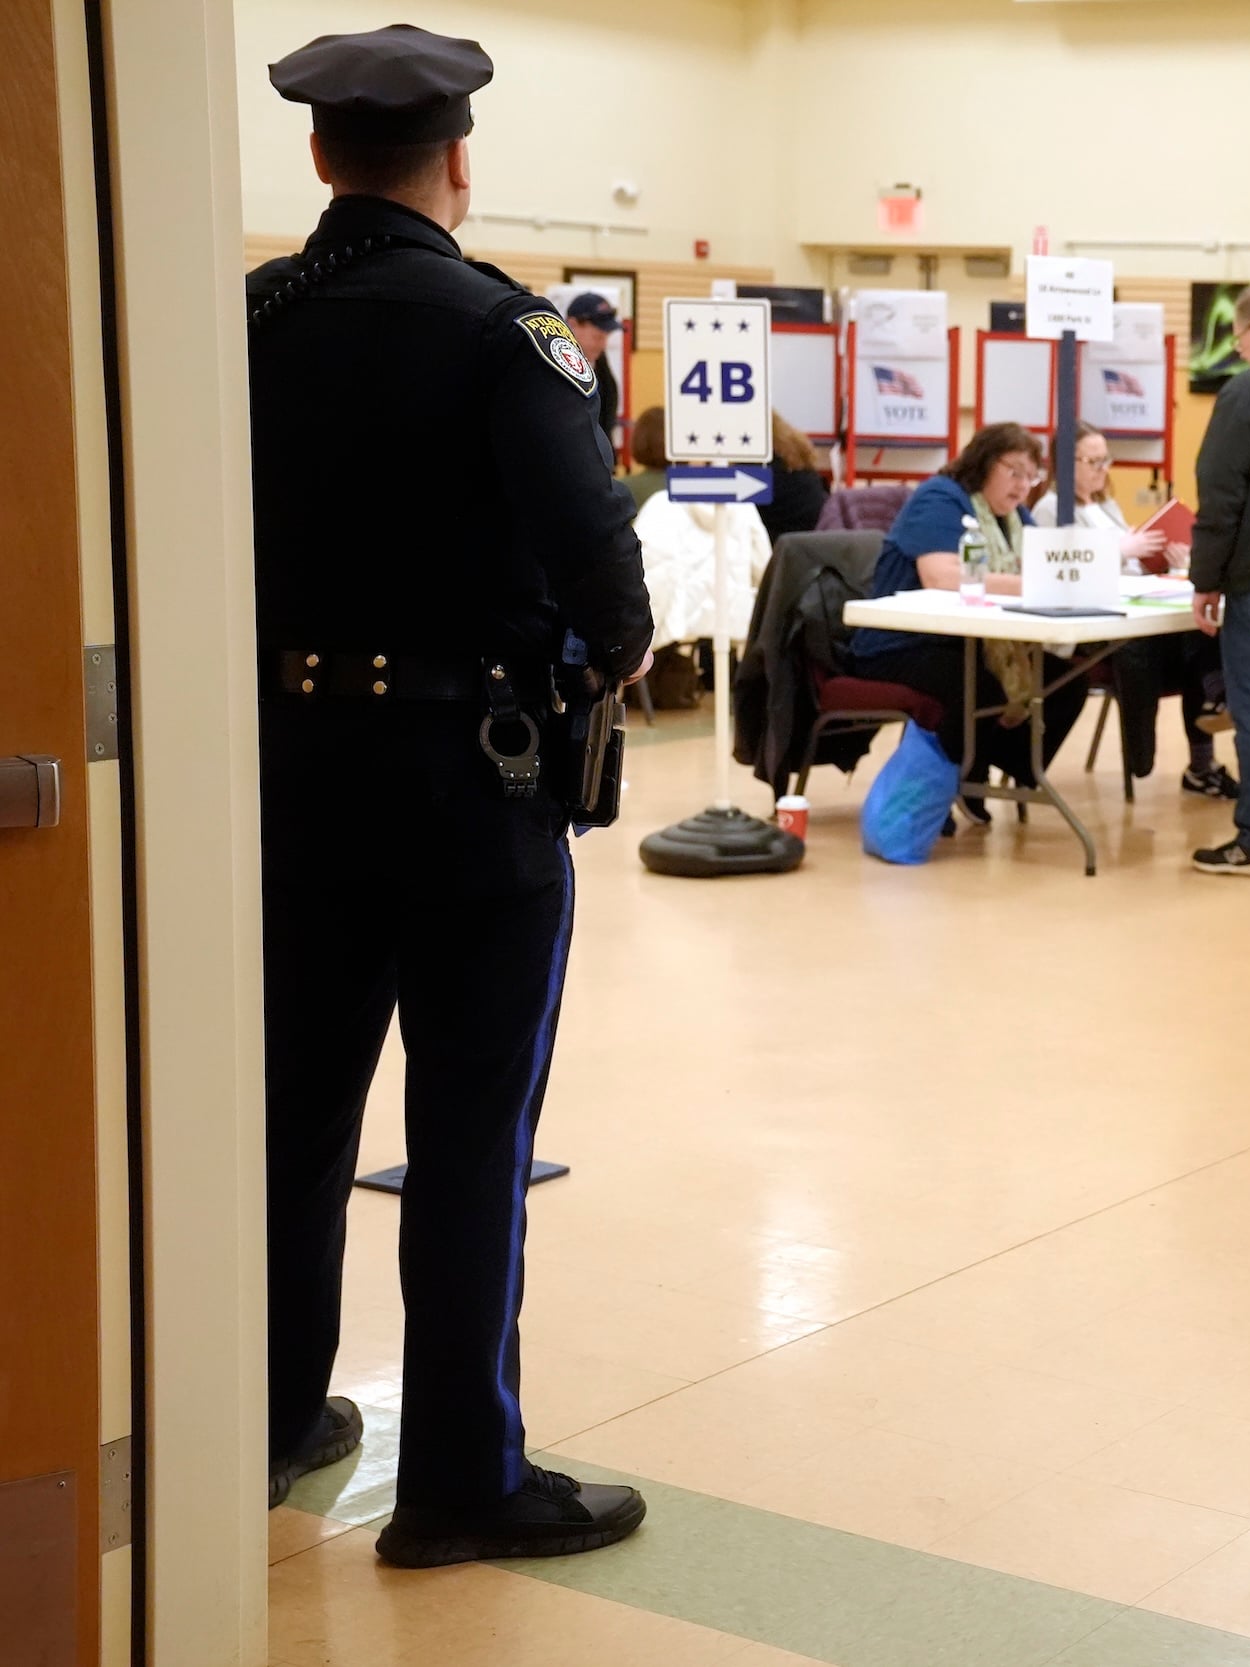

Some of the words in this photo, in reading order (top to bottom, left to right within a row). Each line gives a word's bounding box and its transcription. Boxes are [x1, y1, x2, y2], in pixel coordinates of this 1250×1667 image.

[680, 360, 755, 403] 4B
[884, 405, 928, 420] VOTE
[1110, 402, 1147, 416] VOTE
[1045, 549, 1094, 563] WARD
